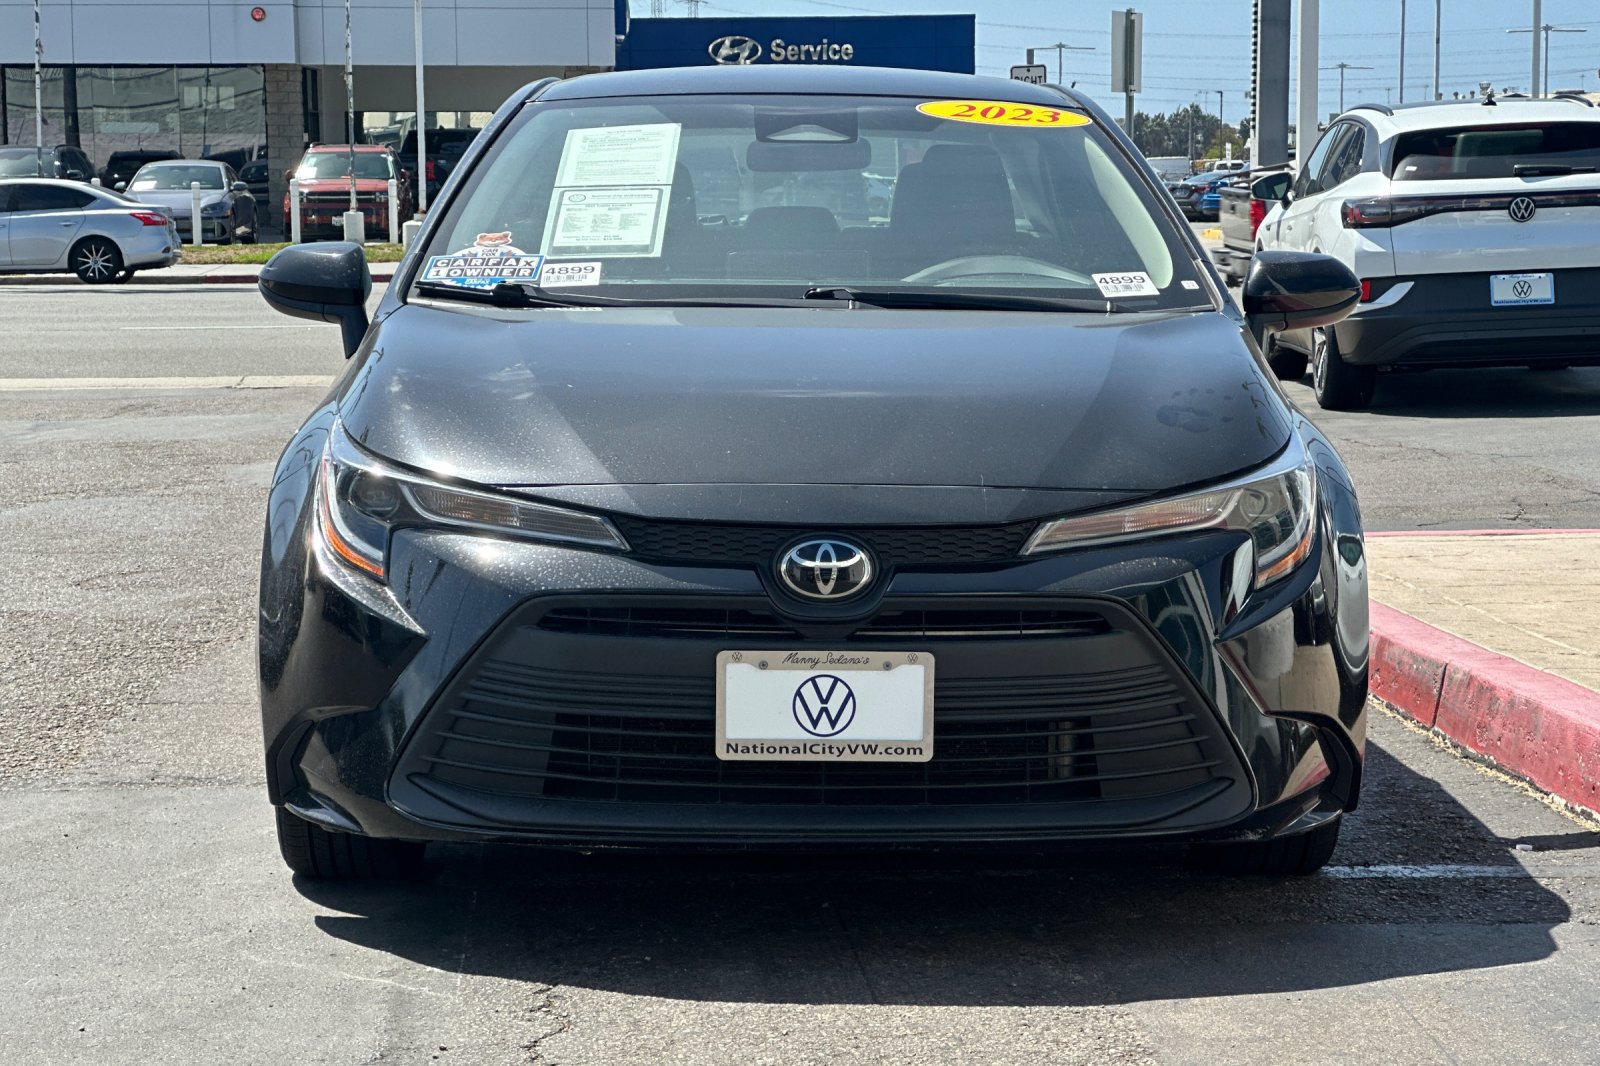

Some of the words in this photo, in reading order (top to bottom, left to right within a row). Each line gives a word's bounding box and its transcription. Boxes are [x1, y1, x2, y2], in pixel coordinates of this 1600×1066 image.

[769, 38, 854, 62] Service
[950, 104, 1061, 123] 2023
[435, 257, 535, 267] CARFAX
[432, 268, 442, 277] 1
[448, 268, 532, 277] OWNER
[544, 265, 596, 275] 4899
[1099, 275, 1146, 284] 4899
[781, 652, 821, 669] Manny
[725, 742, 924, 758] NationalCityVW.com
